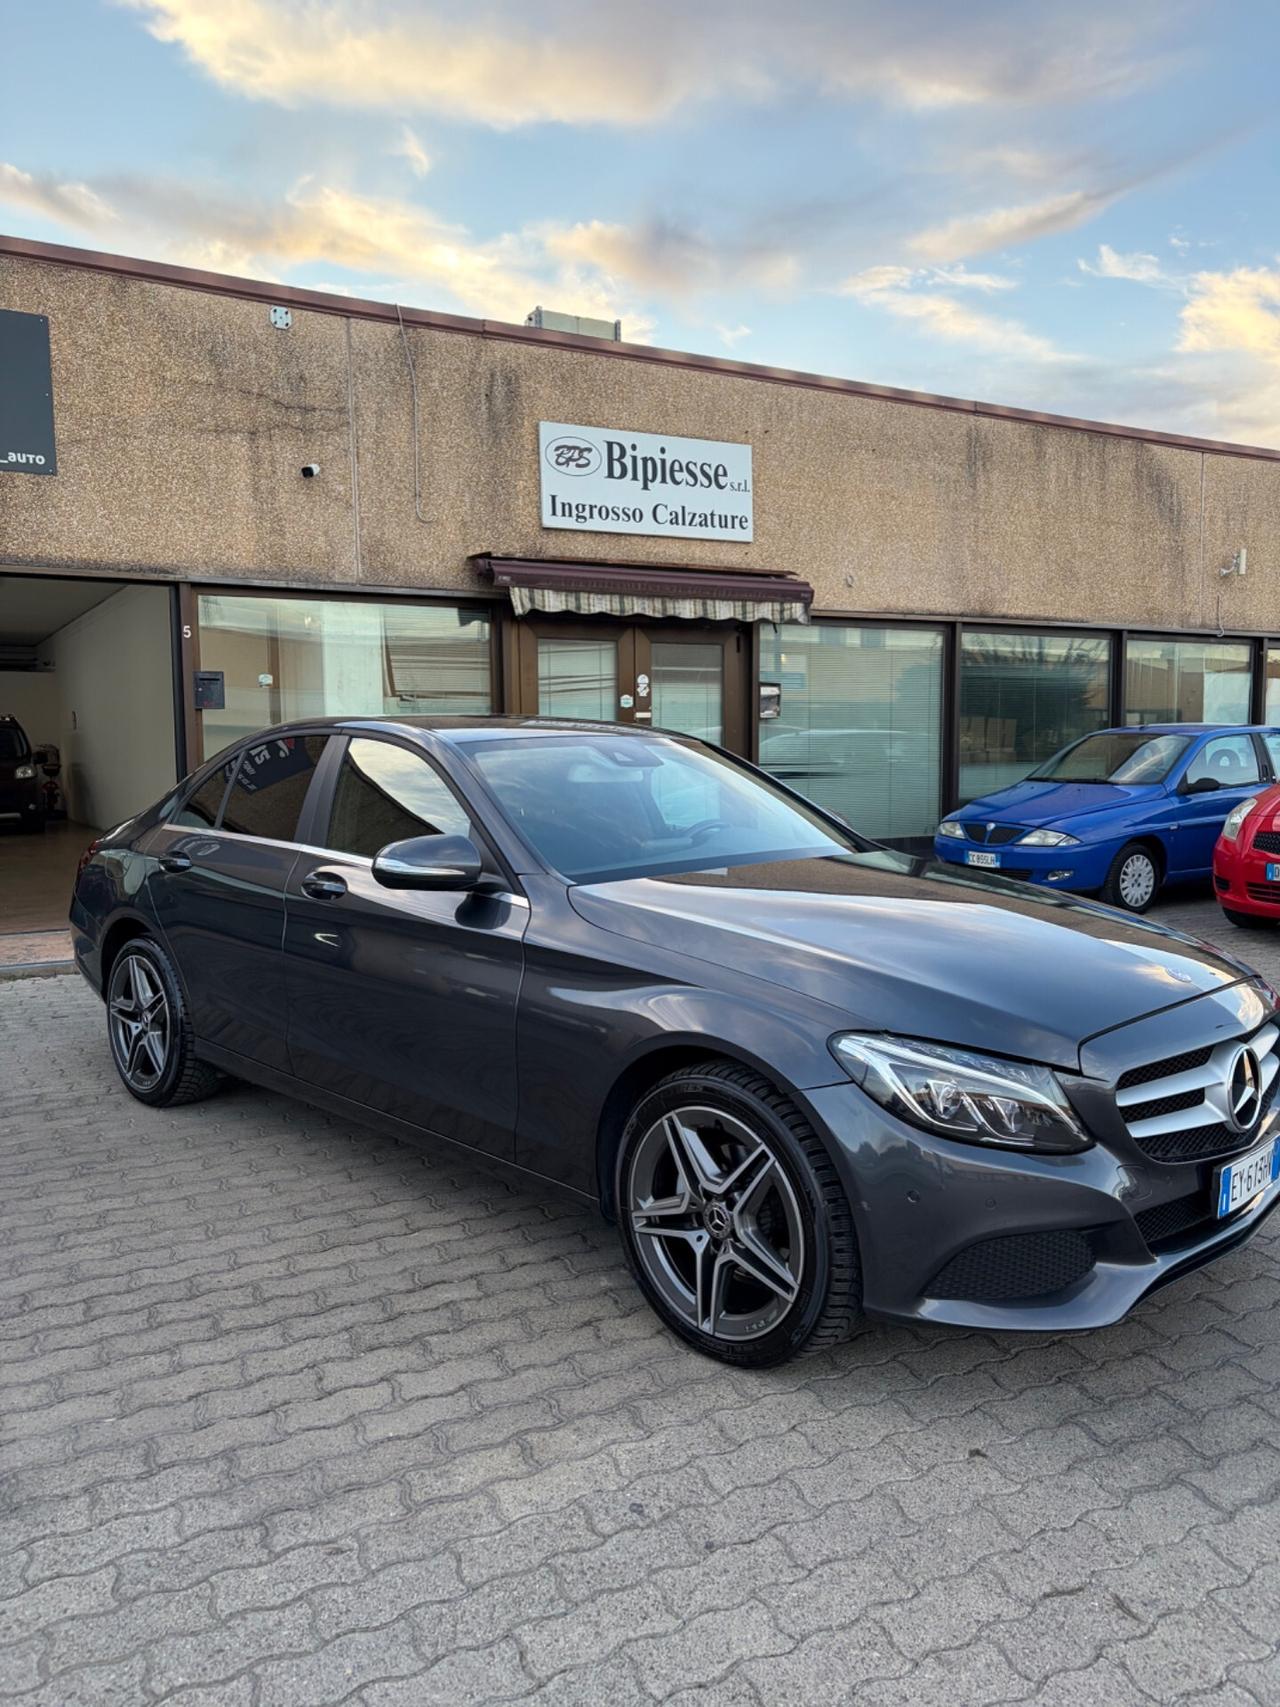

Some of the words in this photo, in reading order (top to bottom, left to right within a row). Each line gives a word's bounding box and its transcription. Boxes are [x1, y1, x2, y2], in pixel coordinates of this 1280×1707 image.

[603, 440, 729, 491] Bipiesse
[730, 479, 751, 493] s.r.l.
[550, 494, 644, 523] Ingrosso
[652, 503, 749, 530] Calzature
[183, 625, 192, 638] 5
